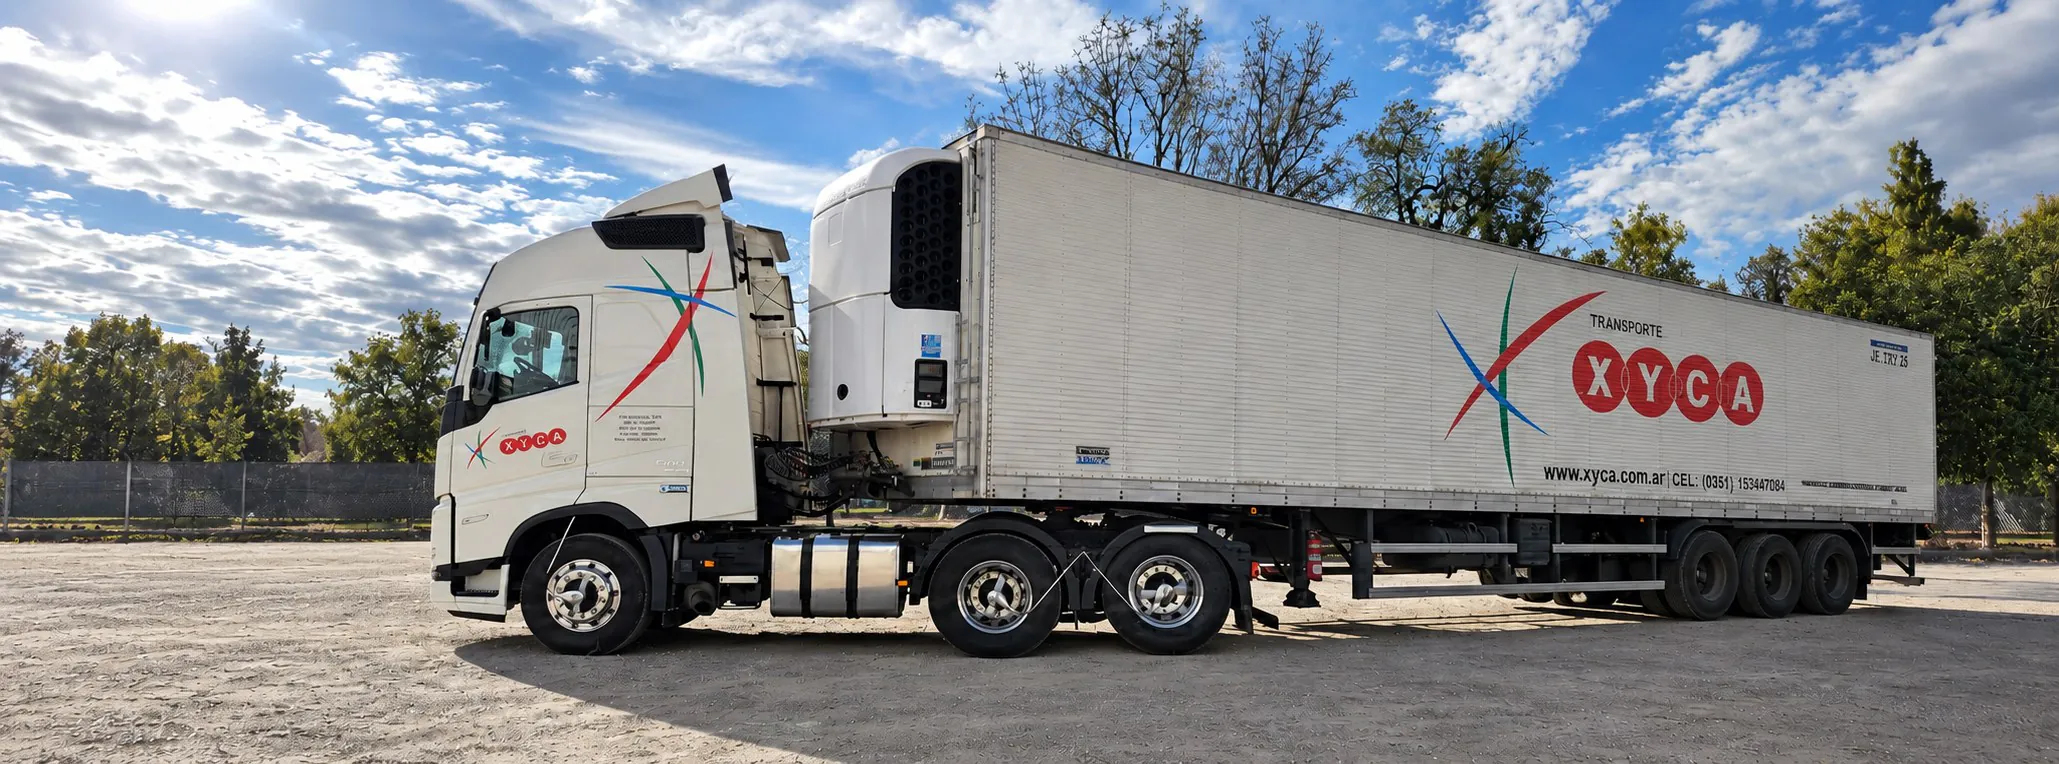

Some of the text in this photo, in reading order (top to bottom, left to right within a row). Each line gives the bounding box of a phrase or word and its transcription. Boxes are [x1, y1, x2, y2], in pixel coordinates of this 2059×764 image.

[1590, 313, 1663, 338] TRANSPORTE
[1586, 355, 1755, 414] XYCA
[1543, 466, 1666, 487] www.xyca.com.ar
[1672, 472, 1699, 488] CEL:
[1702, 474, 1734, 494] (0351)
